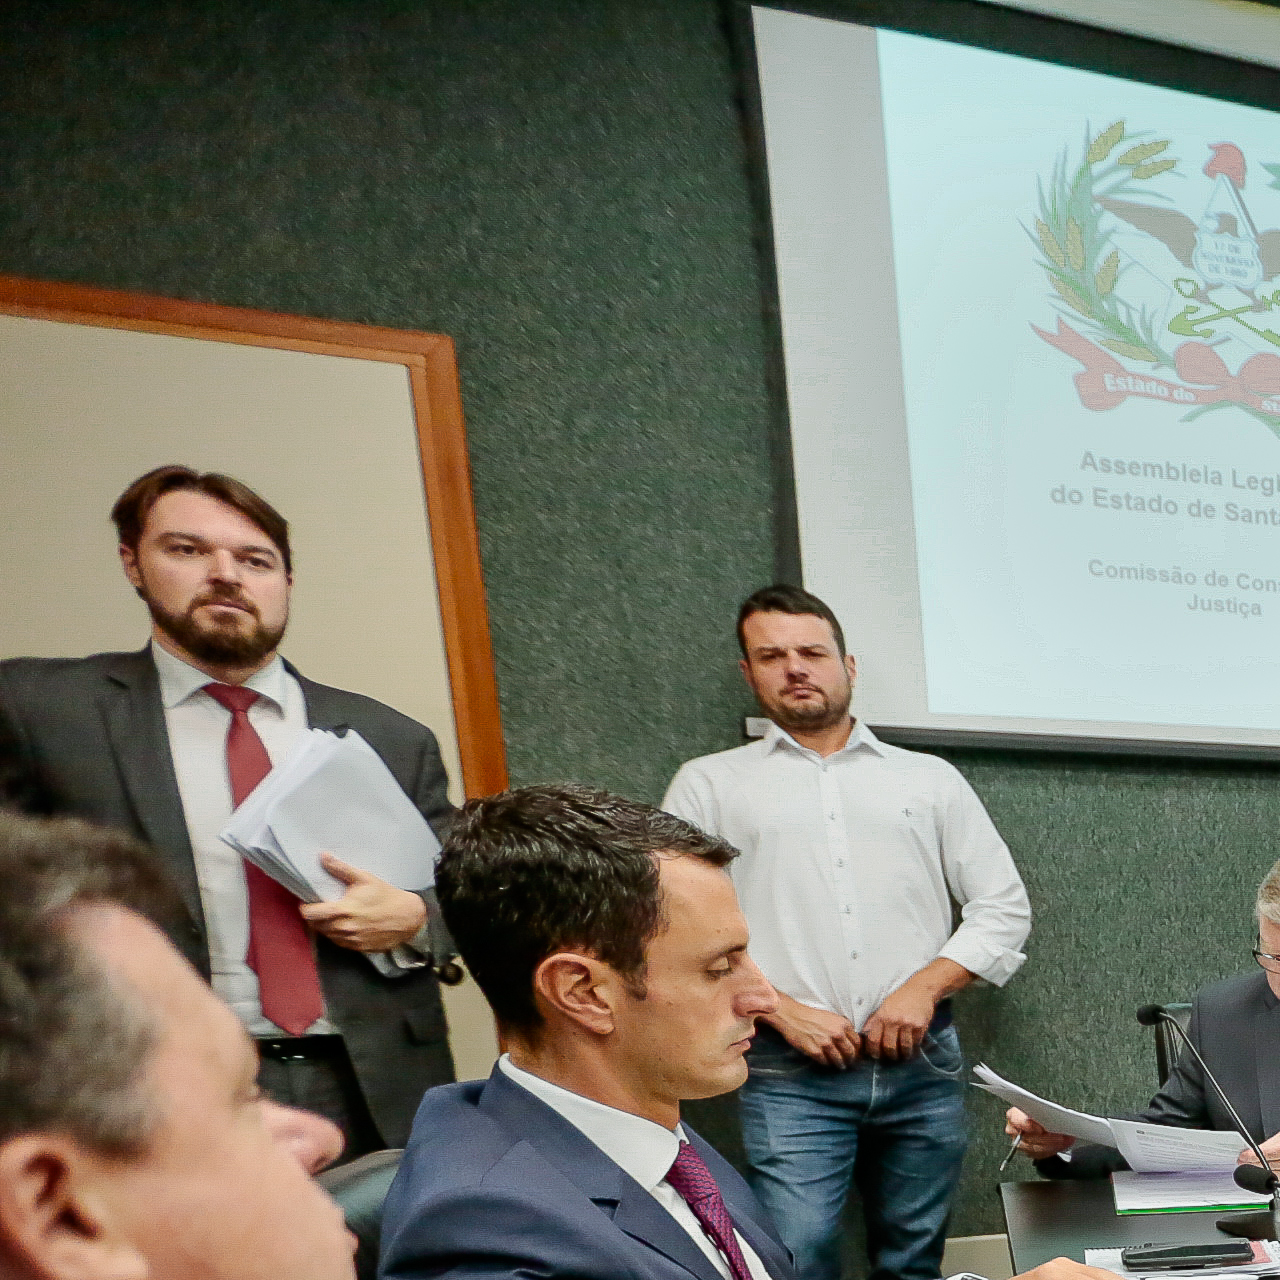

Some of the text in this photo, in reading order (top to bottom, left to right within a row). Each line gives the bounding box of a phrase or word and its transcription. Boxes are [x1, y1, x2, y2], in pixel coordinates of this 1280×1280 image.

[1103, 373, 1169, 396] Estado
[1079, 450, 1223, 487] Assembleia
[1050, 484, 1083, 505] do
[1092, 486, 1179, 515] Estado
[1186, 498, 1217, 519] de
[1087, 558, 1198, 587] Comissão
[1203, 569, 1230, 588] de
[1186, 593, 1263, 619] Justiça
